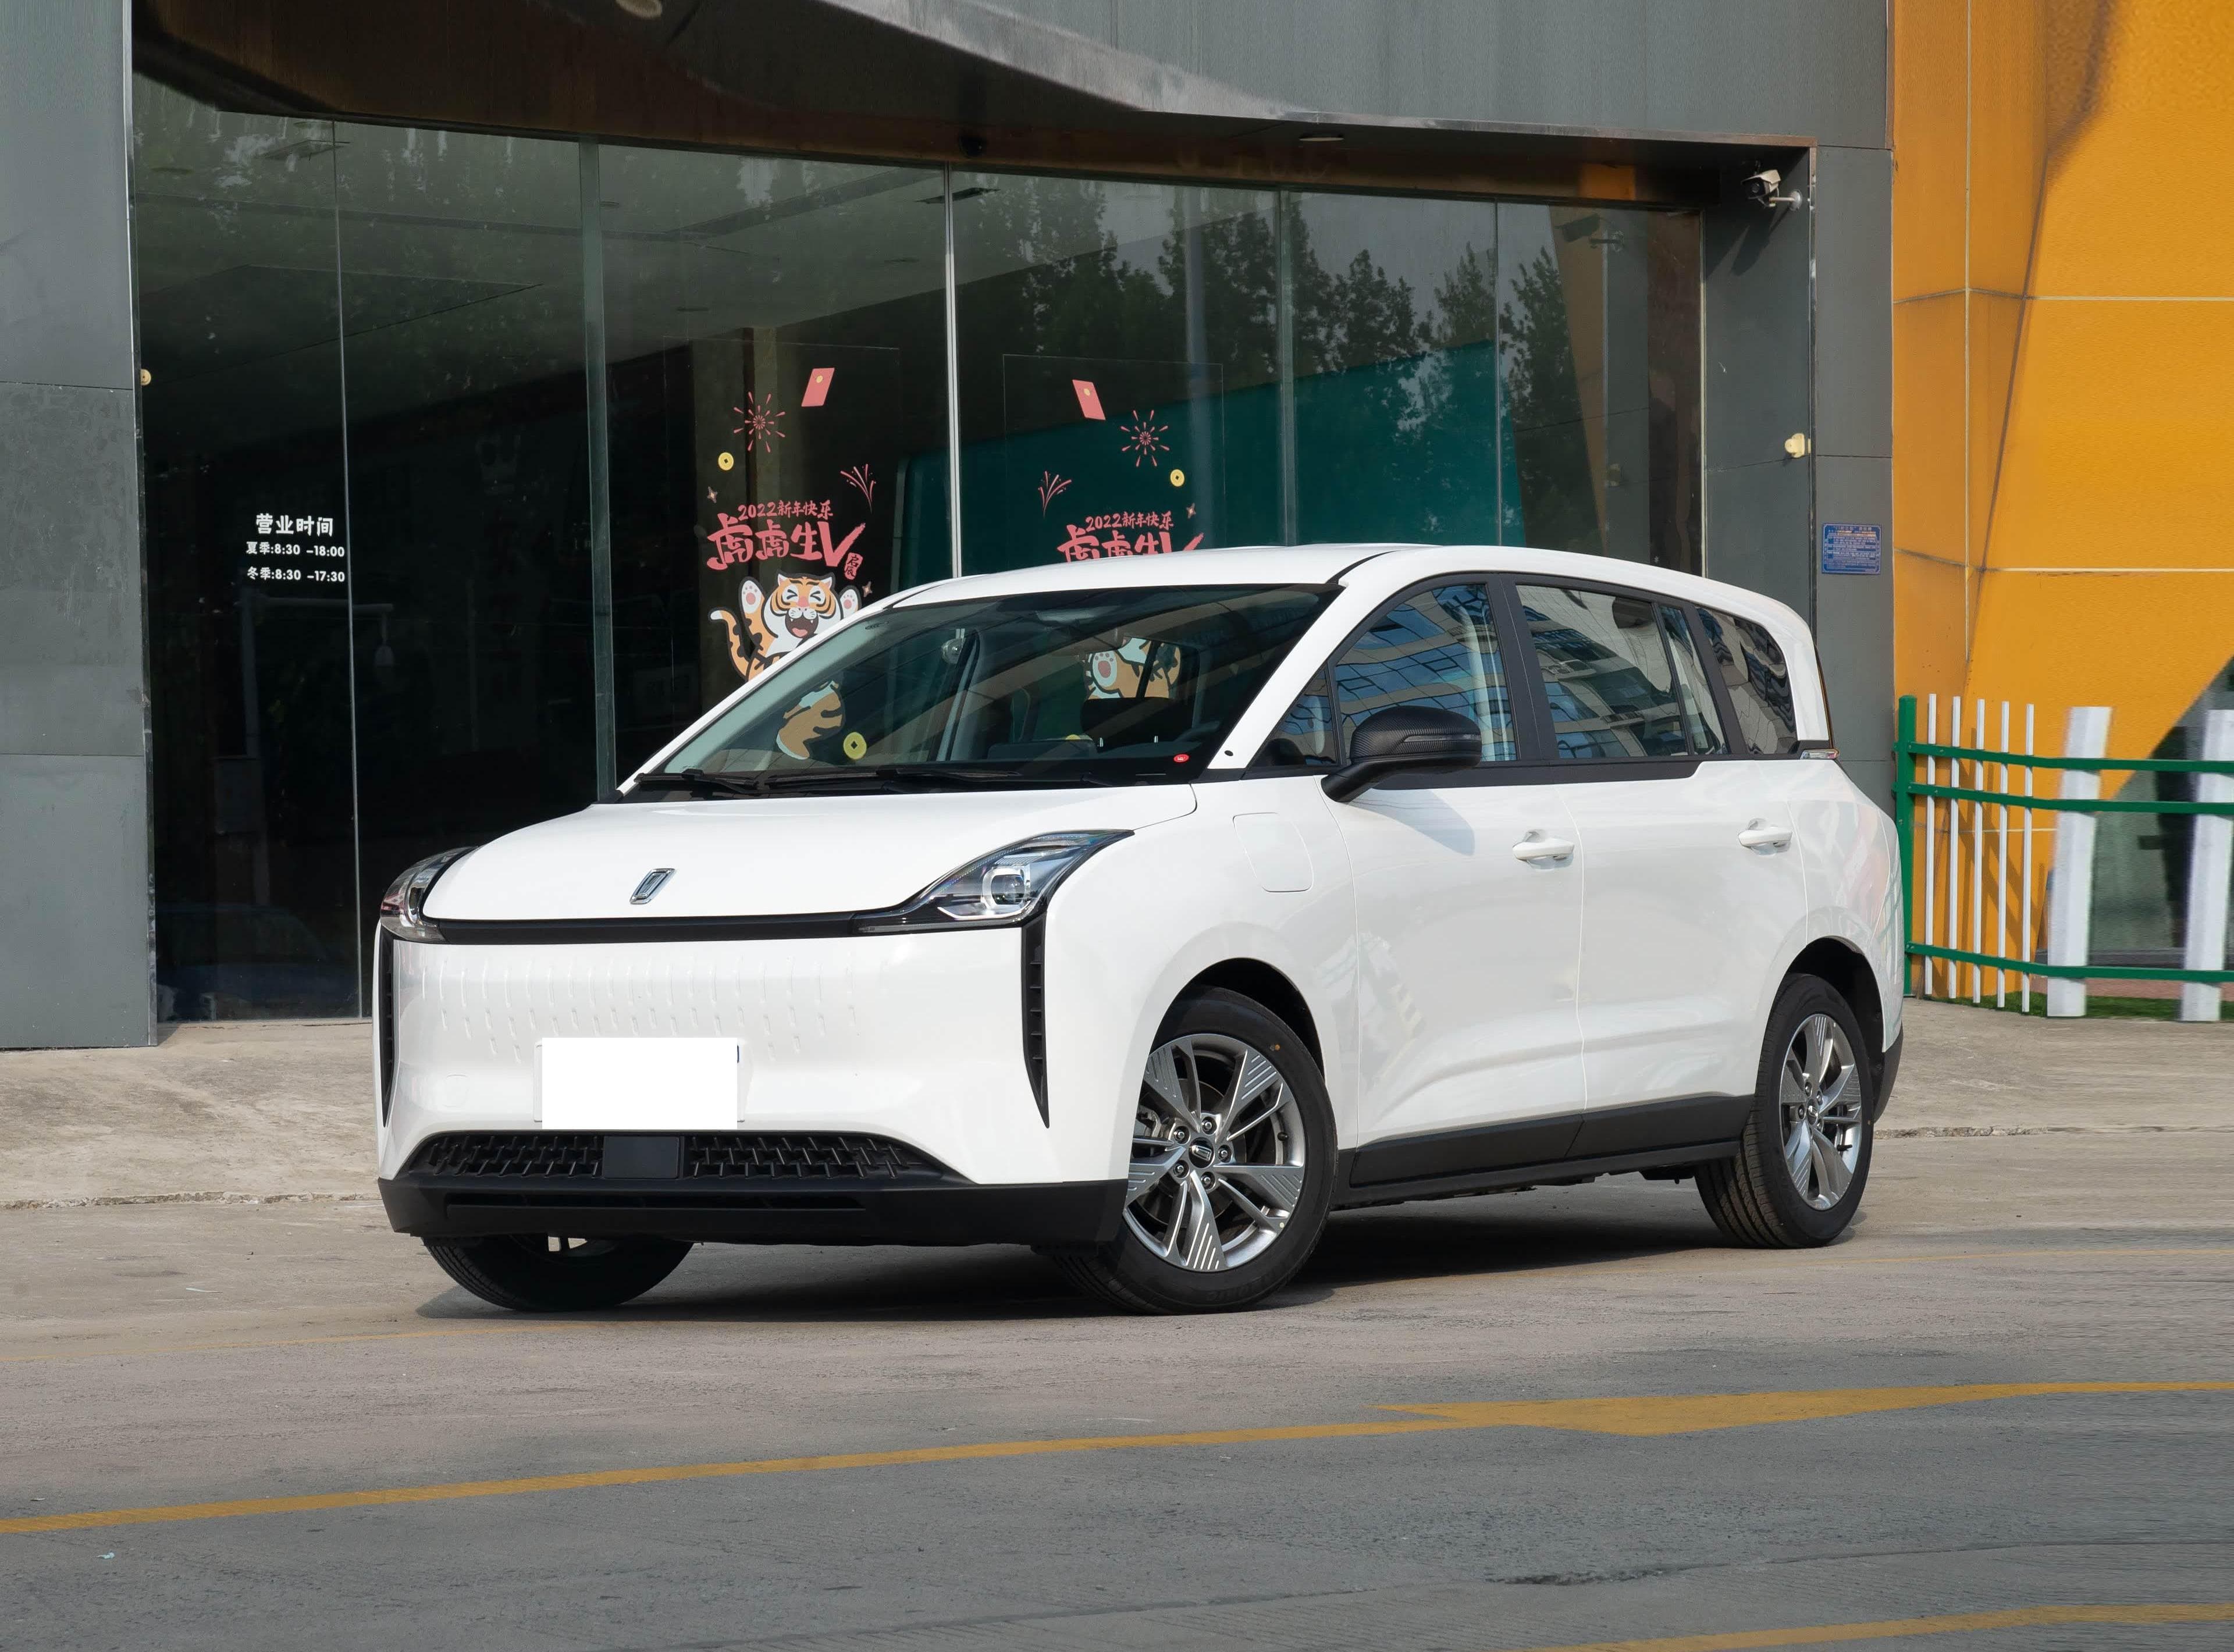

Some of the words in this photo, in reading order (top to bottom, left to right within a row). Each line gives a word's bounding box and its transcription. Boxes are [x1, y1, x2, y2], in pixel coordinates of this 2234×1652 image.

[738, 500, 834, 521] 2022新年快乐
[1086, 511, 1174, 531] 2022新年快乐
[255, 512, 334, 537] 营业时间
